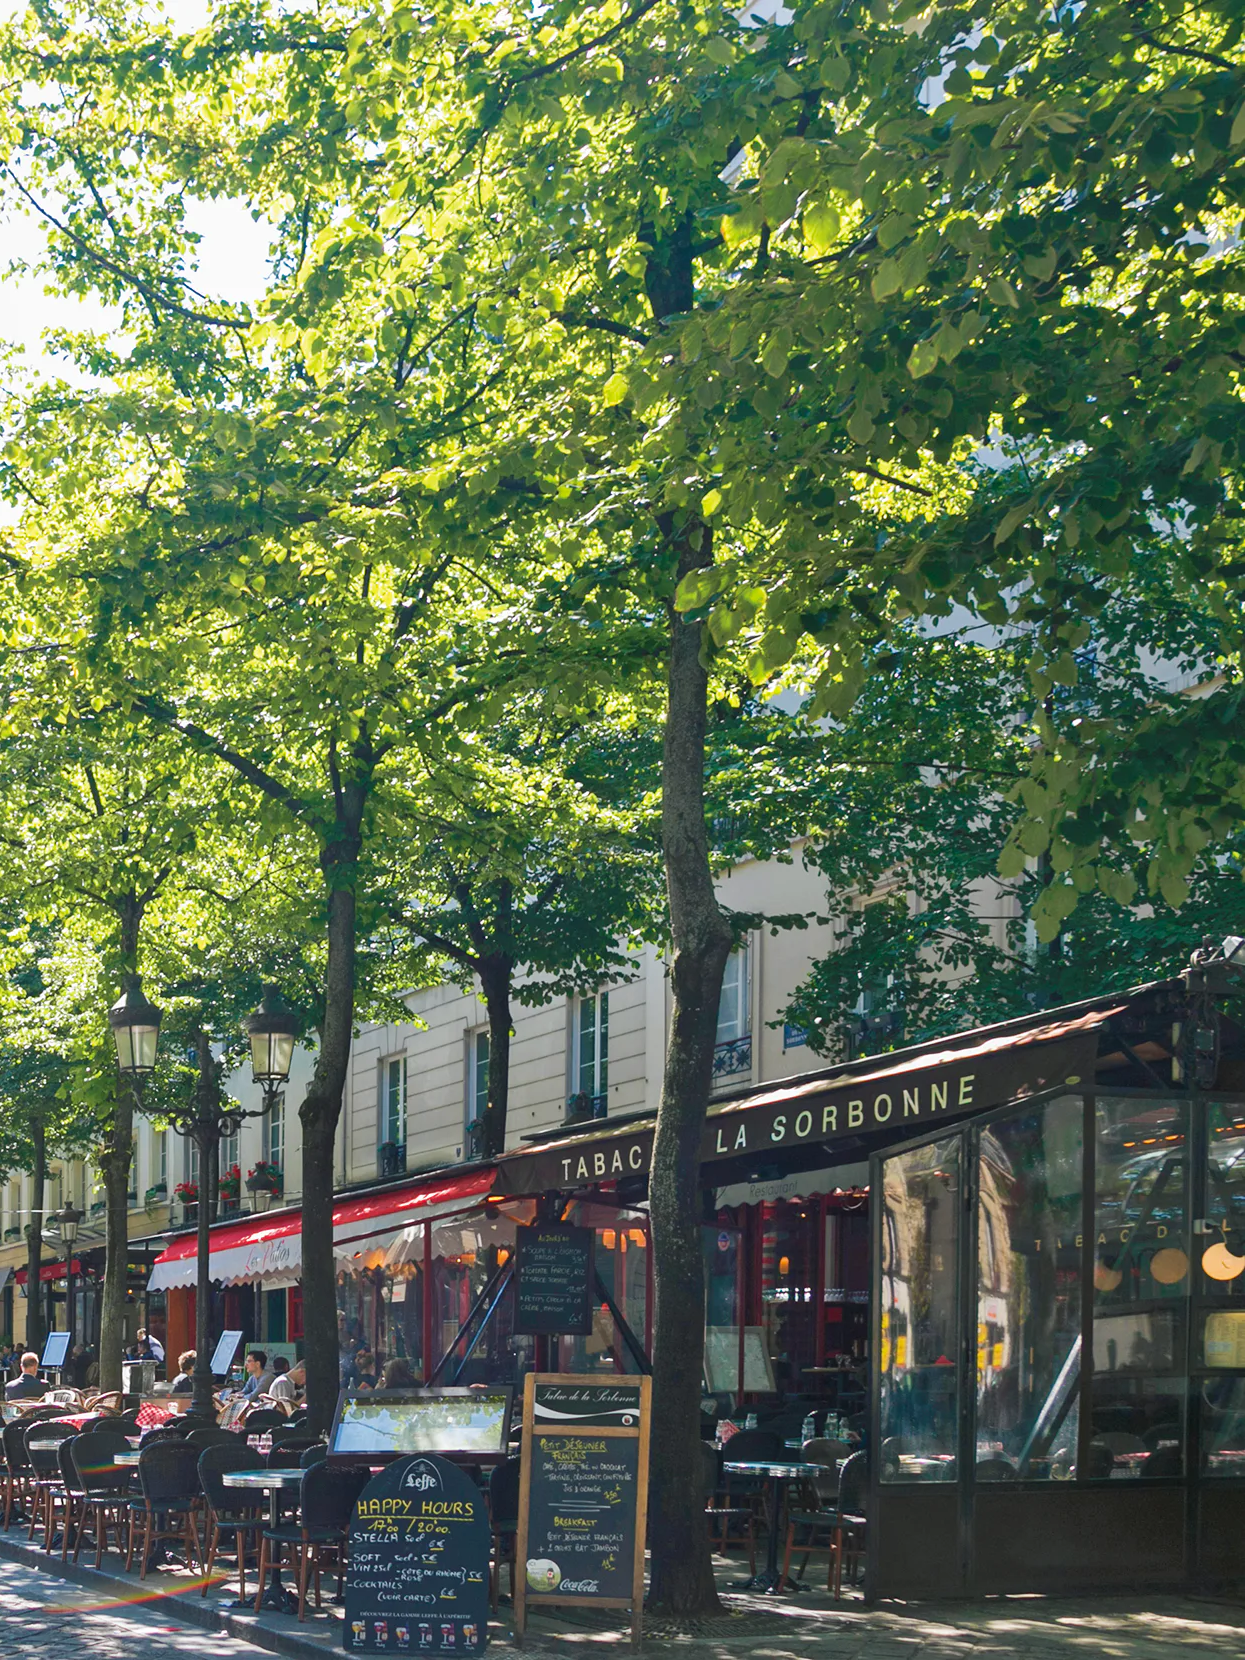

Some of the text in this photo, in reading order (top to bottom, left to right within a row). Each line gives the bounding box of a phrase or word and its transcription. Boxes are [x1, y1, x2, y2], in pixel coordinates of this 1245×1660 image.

[562, 1075, 975, 1181] TABAC LA SORBONNE
[749, 1180, 798, 1198] Restaurant
[262, 1240, 290, 1269] Patios
[569, 1390, 579, 1401] de
[581, 1390, 591, 1401] la
[592, 1388, 637, 1402] Sorbonne
[540, 1438, 560, 1450] PETIT
[405, 1473, 438, 1491] Leffe
[357, 1499, 474, 1516] HAPPY HOURS
[554, 1516, 598, 1527] BREAKFAST
[353, 1532, 399, 1543] STELLA
[590, 1544, 620, 1552] JAMBON
[353, 1553, 381, 1562] SOFT
[353, 1579, 403, 1589] COCKTAILS
[403, 1593, 437, 1604] CARTE)
